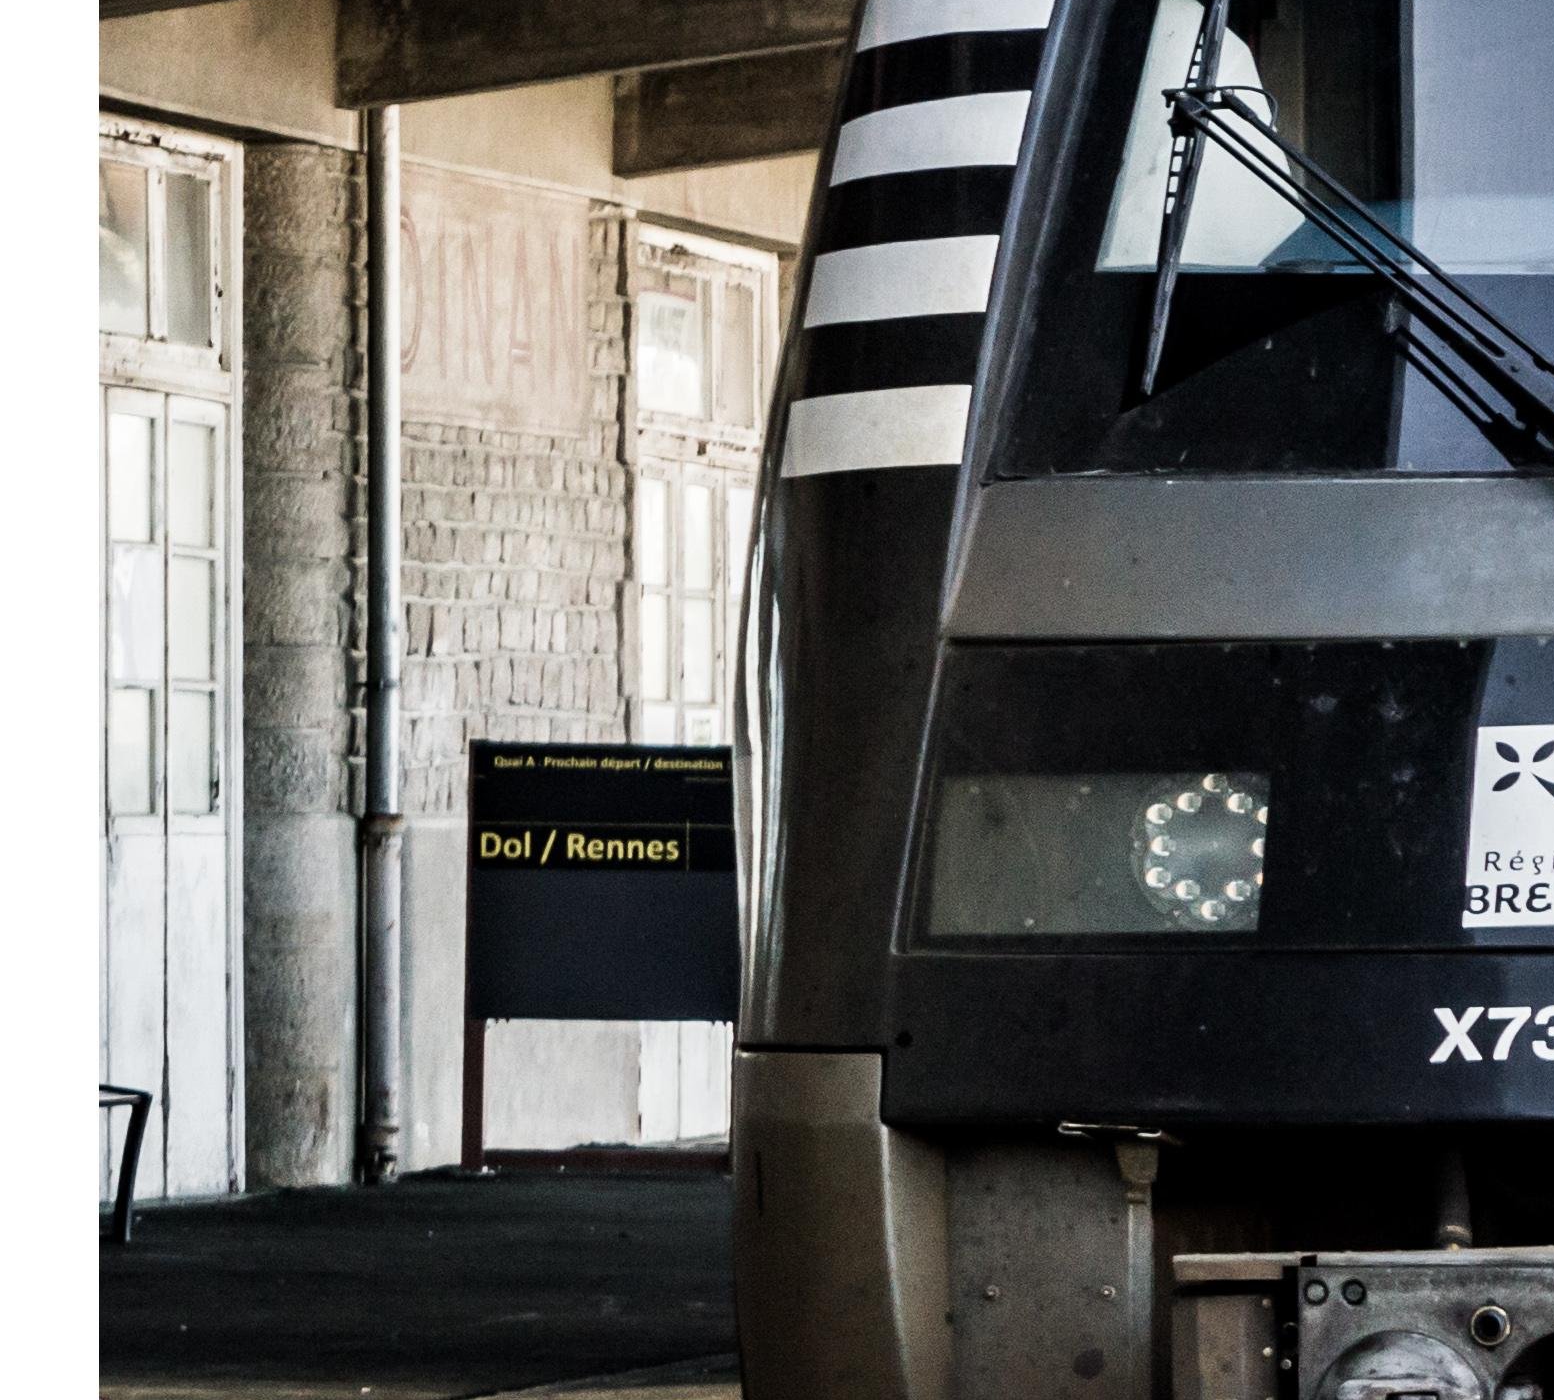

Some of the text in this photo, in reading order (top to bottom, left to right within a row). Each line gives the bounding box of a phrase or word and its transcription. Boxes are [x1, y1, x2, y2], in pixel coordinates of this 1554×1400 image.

[526, 755, 536, 768] A
[543, 755, 598, 769] Prochain
[653, 757, 724, 770] destination
[480, 829, 680, 865] Dol / Rennes
